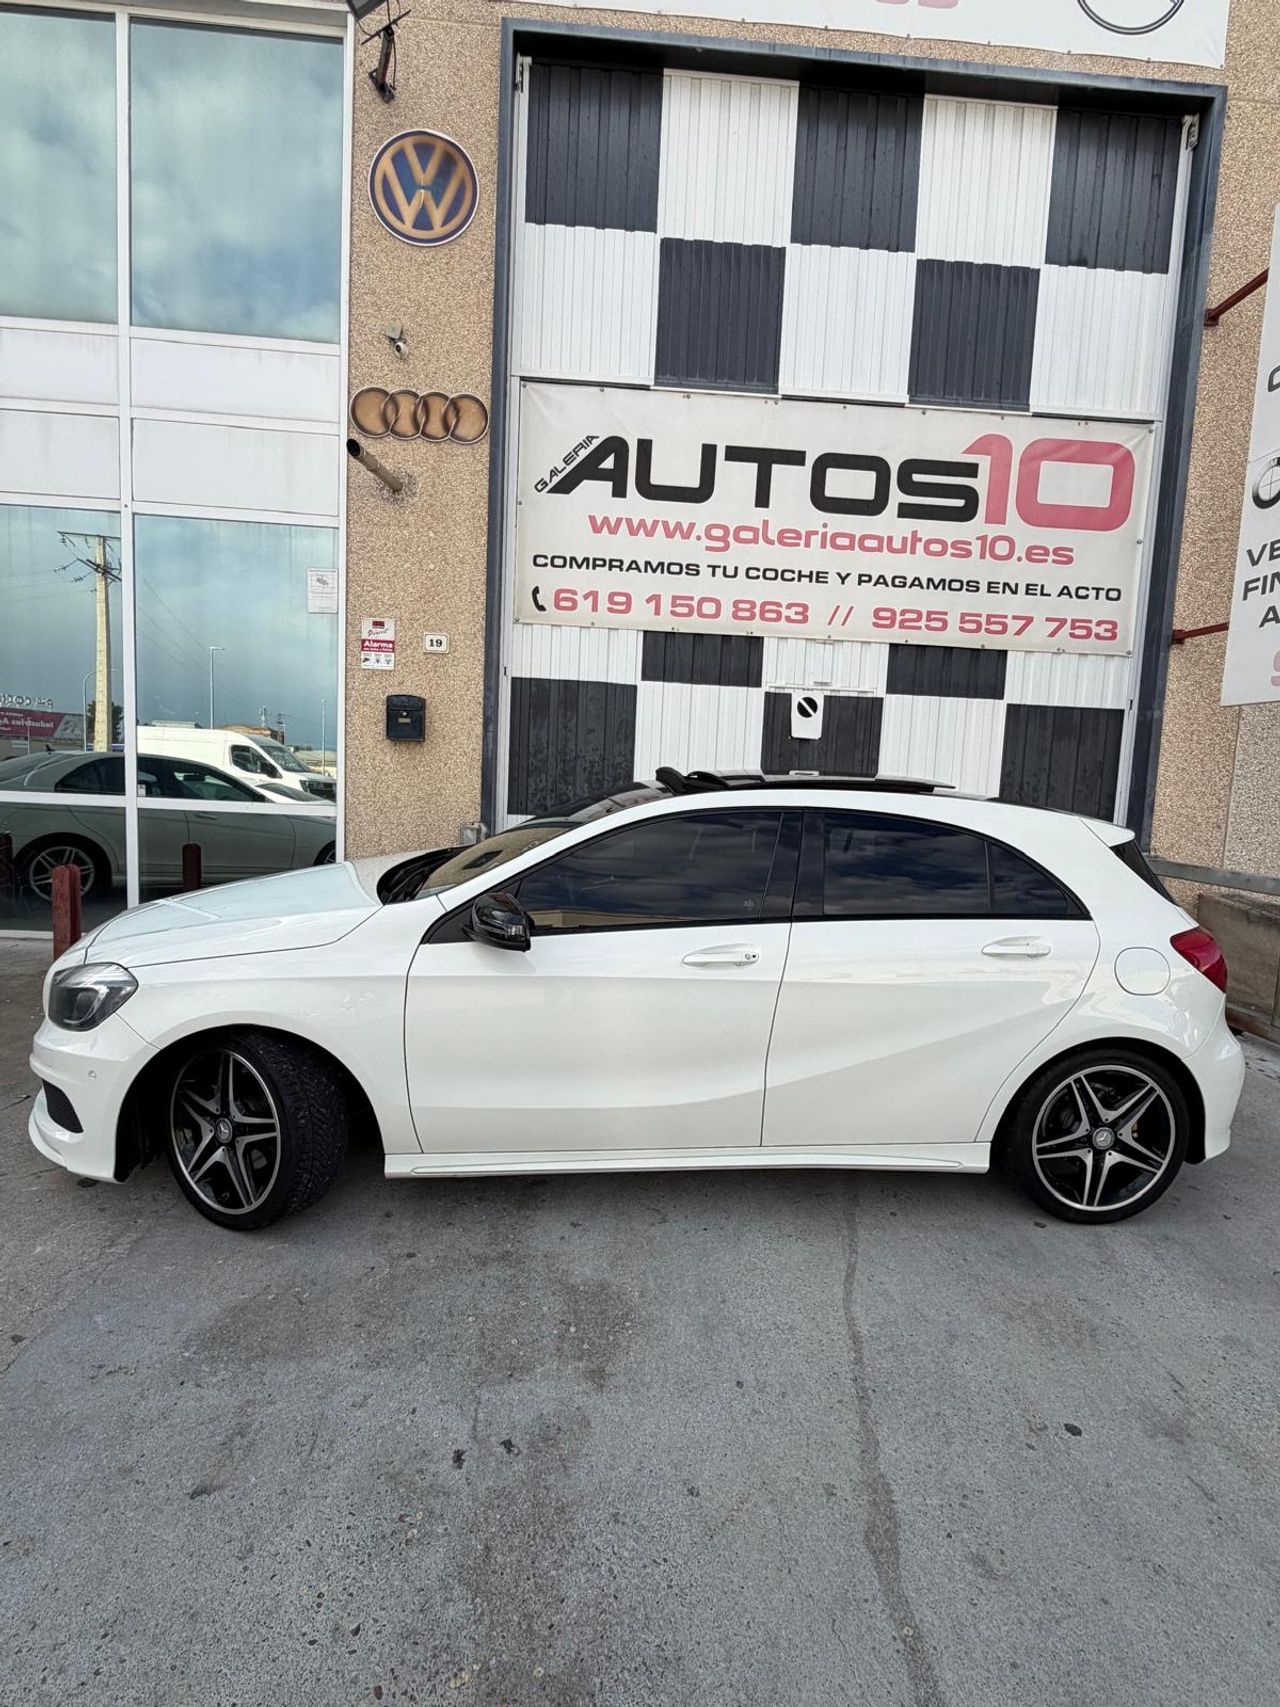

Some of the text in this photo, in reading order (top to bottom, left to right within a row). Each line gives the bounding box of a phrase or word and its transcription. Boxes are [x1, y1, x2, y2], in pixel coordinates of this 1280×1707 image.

[534, 435, 600, 493] GALERIA
[588, 514, 1075, 566] www.galeriaautos10.es
[532, 554, 1122, 602] COMPRAMOS TU COCHE Y PAGAMOS EN EL ACTO
[553, 587, 633, 615] 619
[645, 593, 722, 620] 150
[731, 598, 809, 625] 863
[871, 606, 949, 633] 925
[958, 611, 1034, 637] 557
[1044, 616, 1118, 642] 753
[363, 640, 393, 649] Alarma
[428, 638, 443, 648] 19
